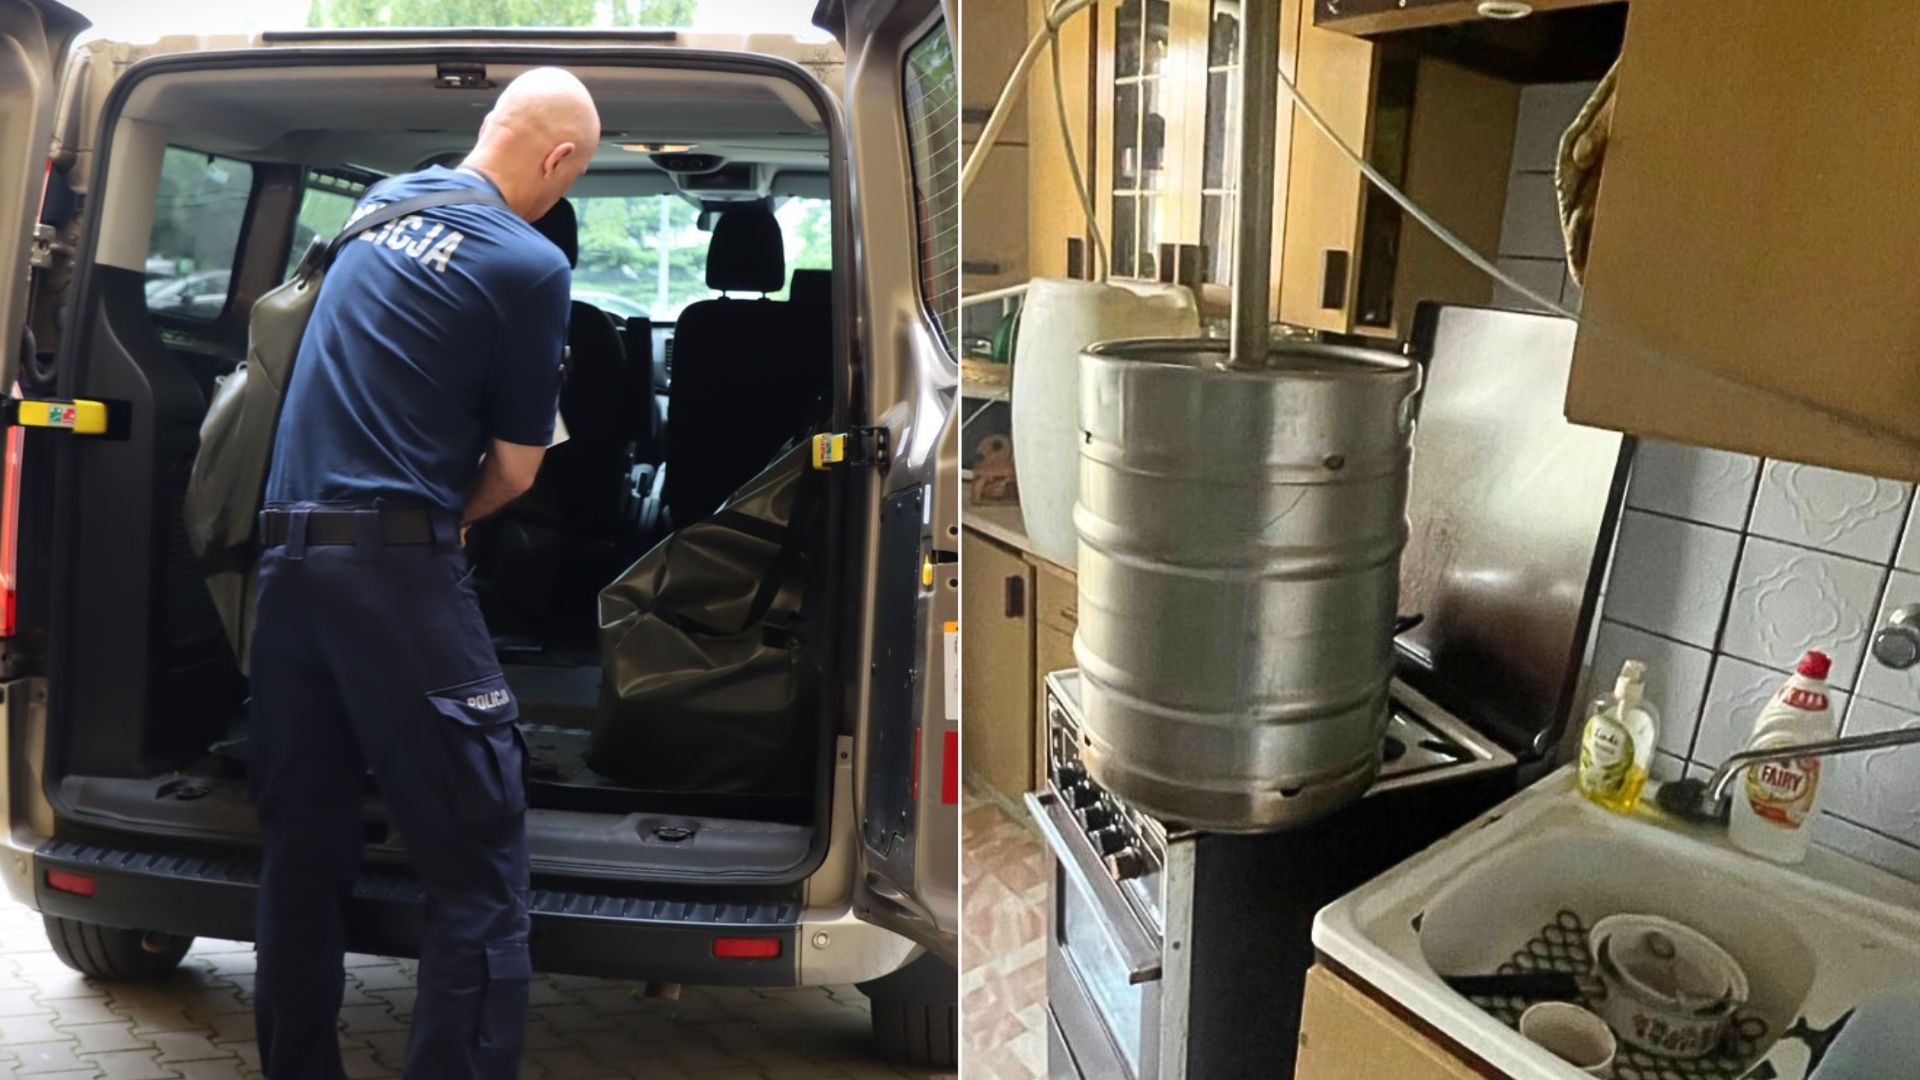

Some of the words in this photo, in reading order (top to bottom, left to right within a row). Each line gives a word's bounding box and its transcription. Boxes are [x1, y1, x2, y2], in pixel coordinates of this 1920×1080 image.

[344, 203, 465, 273] ICJA
[467, 689, 510, 710] POLICJA
[1761, 765, 1803, 792] FAIRY
